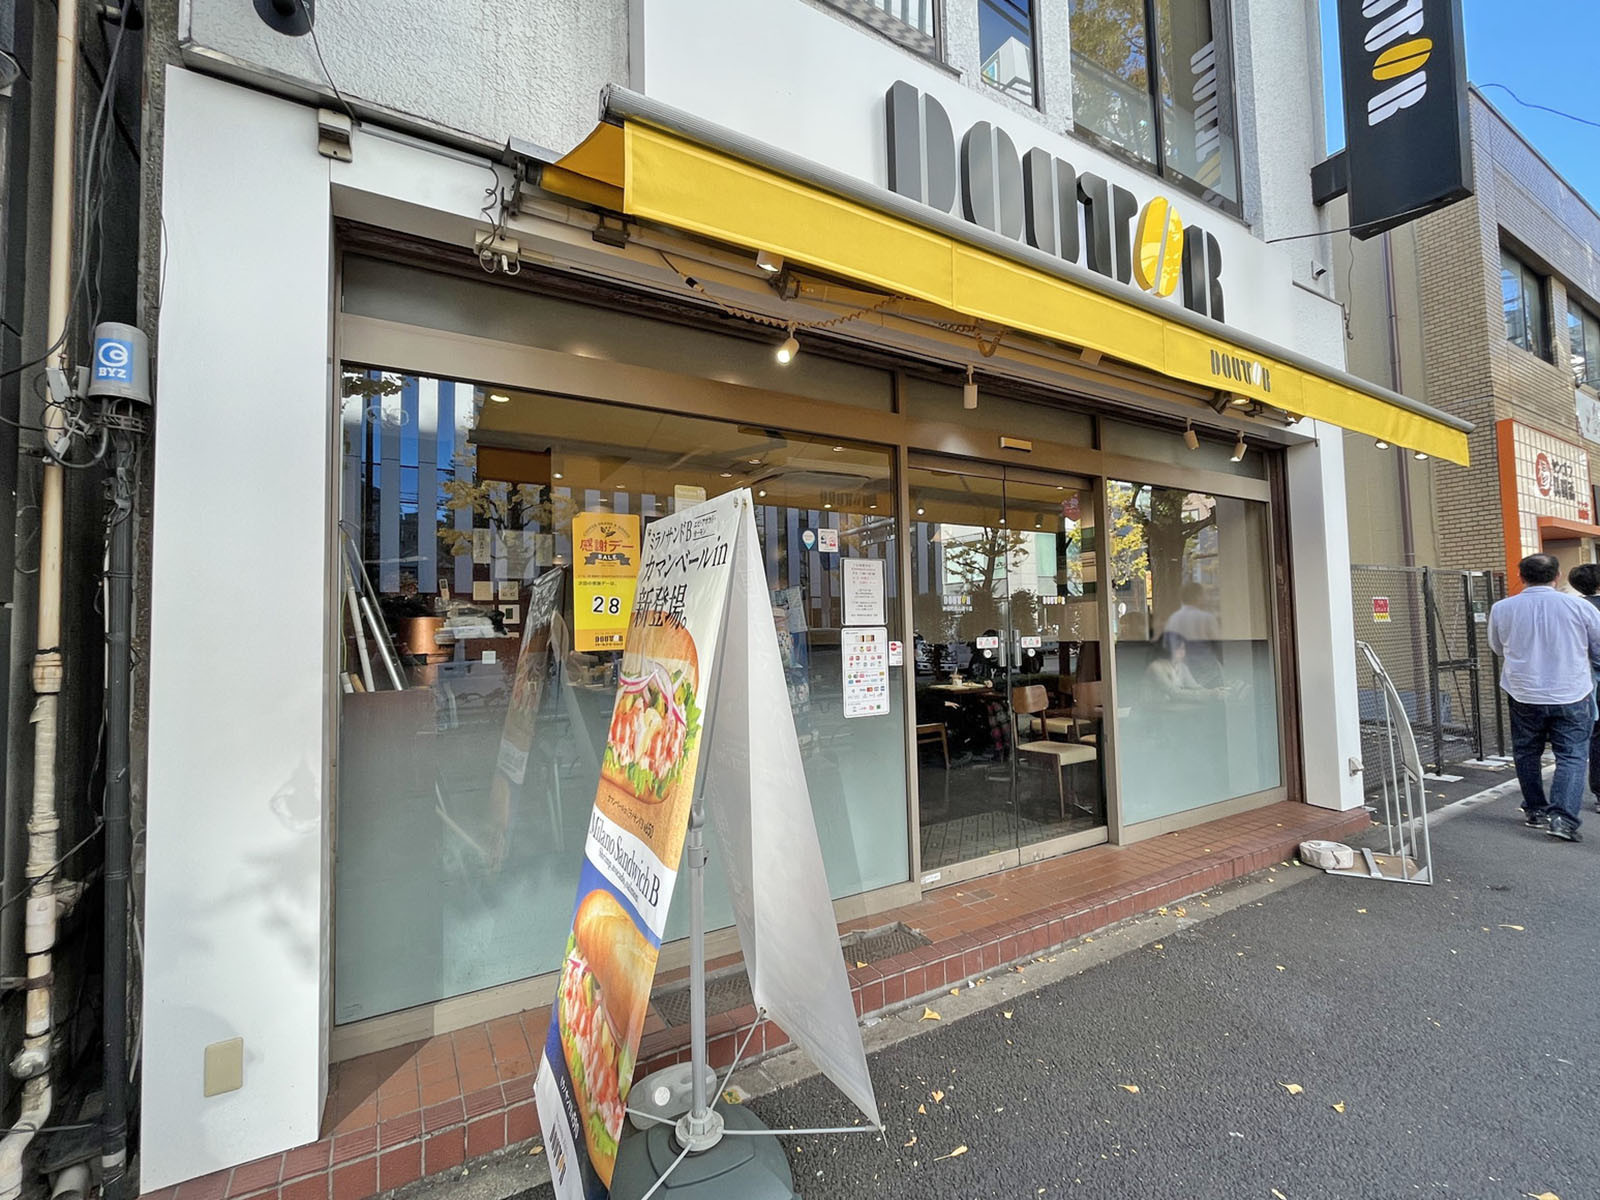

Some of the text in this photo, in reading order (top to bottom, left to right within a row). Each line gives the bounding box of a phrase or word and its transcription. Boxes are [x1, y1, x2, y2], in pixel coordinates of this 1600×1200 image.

[885, 79, 1225, 324] DOUTOR
[1210, 349, 1271, 393] DOUTOR
[579, 538, 634, 553] 感謝デー
[613, 835, 651, 899] Sandwich
[648, 873, 661, 908] B
